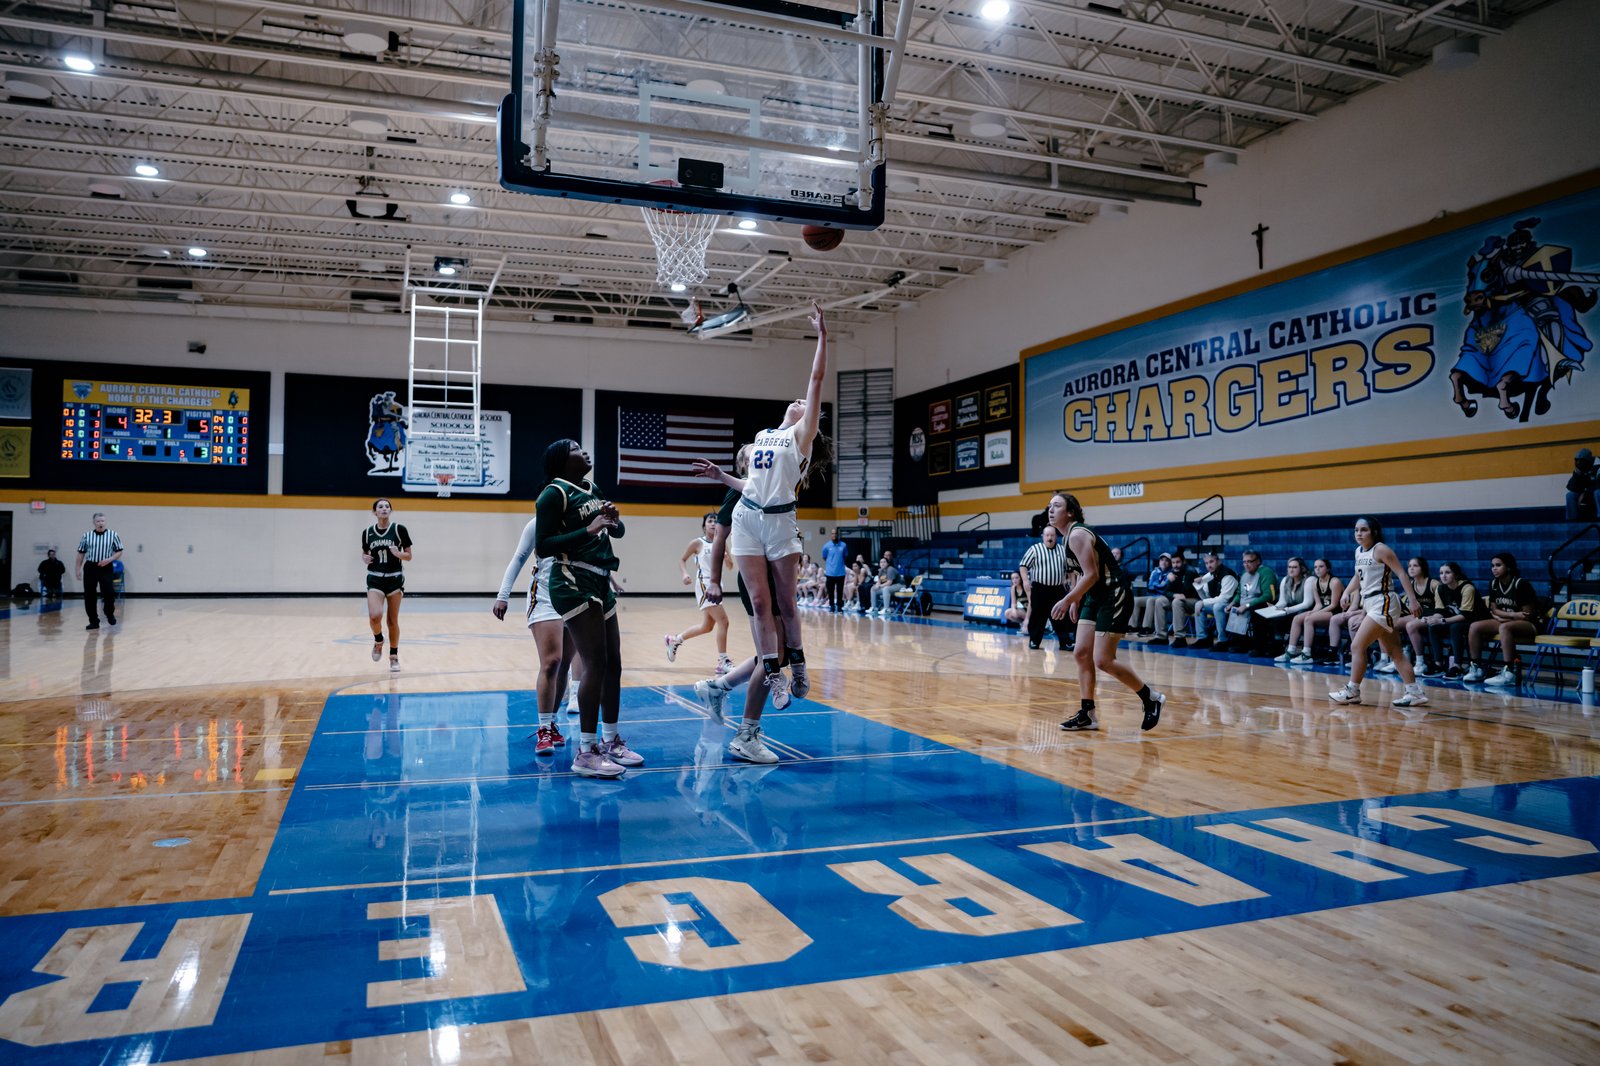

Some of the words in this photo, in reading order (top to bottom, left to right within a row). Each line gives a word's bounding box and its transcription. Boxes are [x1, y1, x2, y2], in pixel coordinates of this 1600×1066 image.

[1063, 360, 1140, 398] AURORA
[1146, 328, 1260, 378] CENTRAL
[1268, 292, 1437, 350] CATHOLIC
[1063, 323, 1436, 443] CHARGERS
[100, 384, 138, 393] AURORA
[139, 386, 176, 396] CENTRAL
[179, 388, 220, 398] CATHOLIC
[108, 394, 133, 402] HOME
[136, 395, 146, 403] OF
[149, 396, 164, 404] THE
[167, 396, 212, 406] CHARGERS
[78, 409, 85, 417] 0
[431, 411, 450, 419] CENTRAL
[451, 412, 473, 420] CATHOLIC
[119, 417, 127, 429] 4
[200, 420, 208, 432] 5
[228, 416, 234, 424] 0
[78, 430, 84, 438] 0
[228, 426, 233, 434] 0
[94, 441, 99, 449] 0
[227, 446, 233, 454] 0
[111, 445, 119, 454] 4
[201, 448, 208, 458] 3
[241, 457, 246, 465] 0
[754, 450, 774, 469] 23
[1112, 483, 1141, 497] VISITORS
[378, 549, 388, 563] 11
[1566, 602, 1597, 616] ACC
